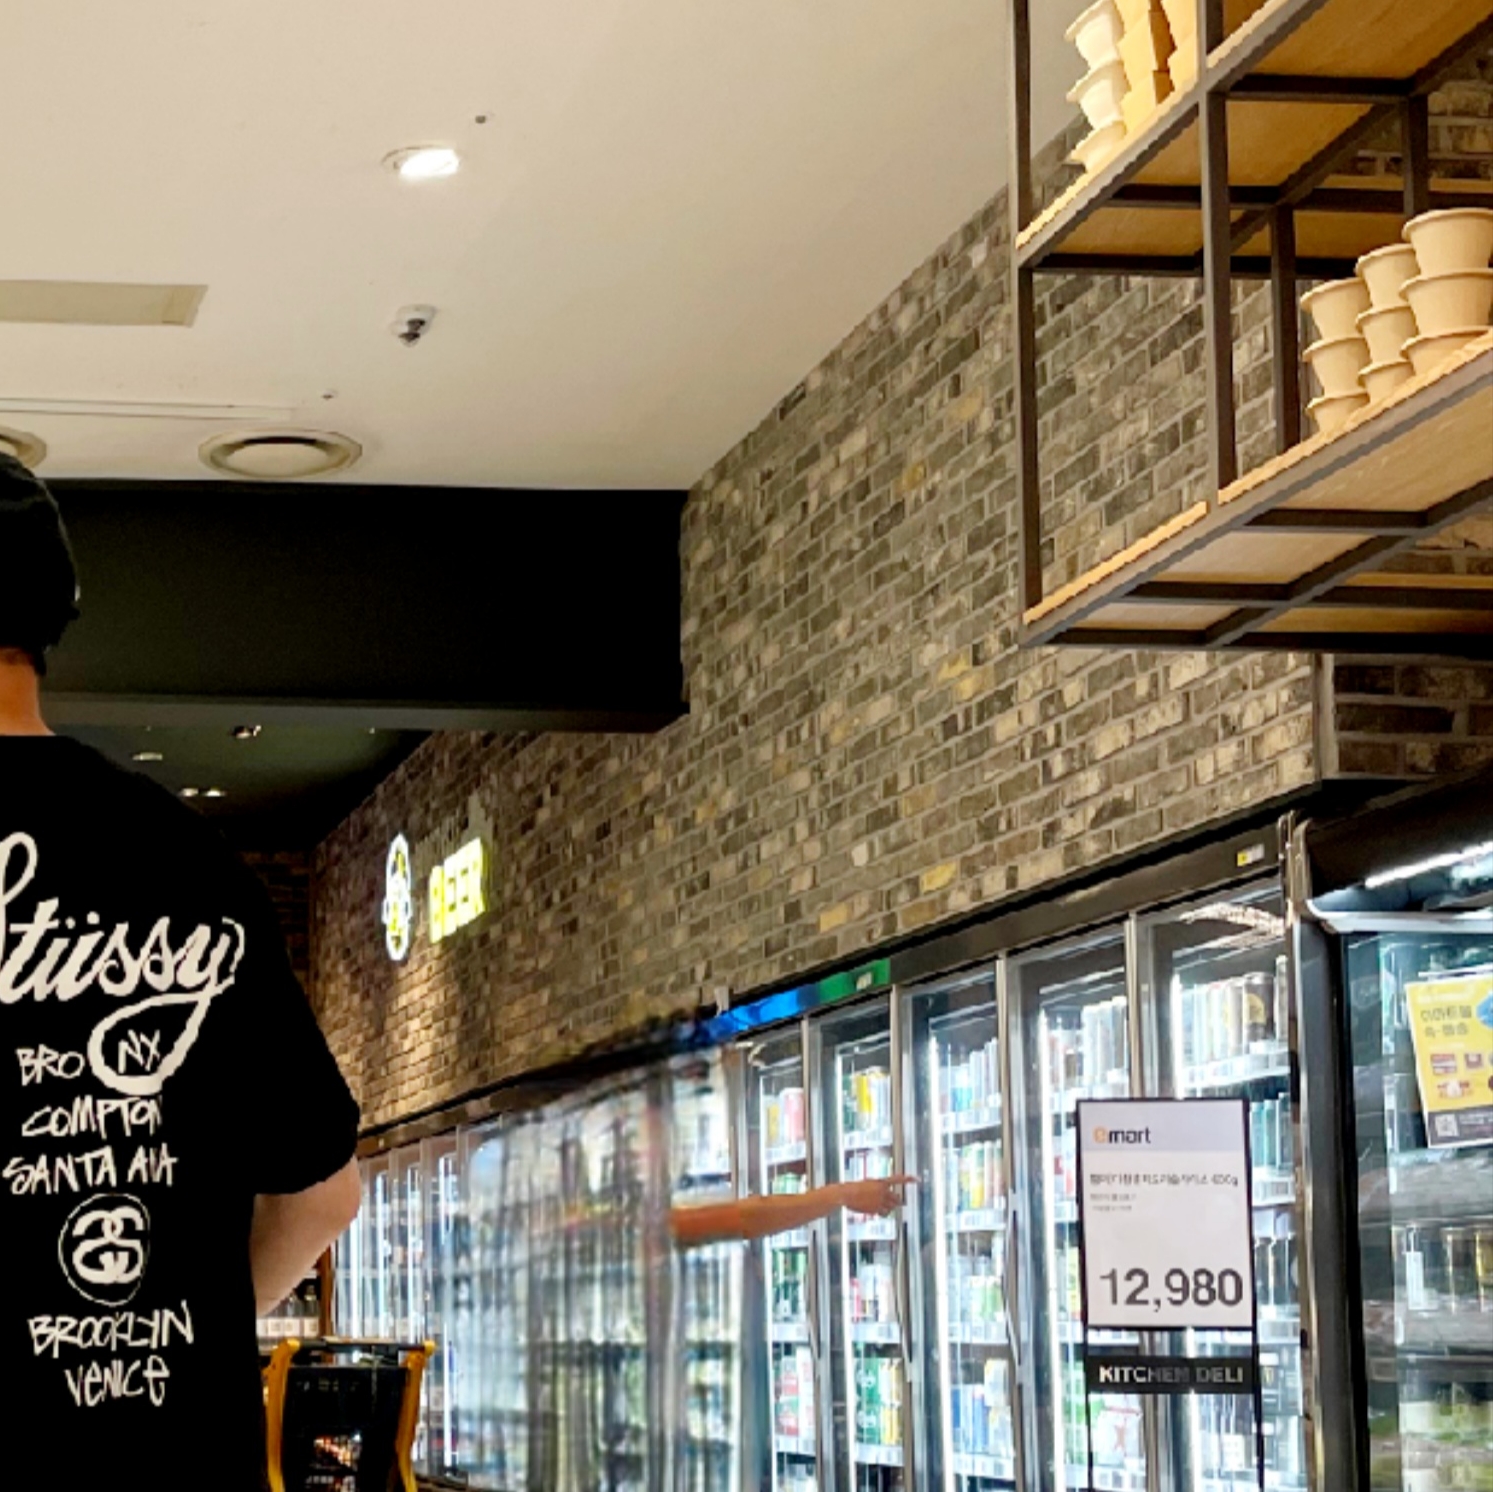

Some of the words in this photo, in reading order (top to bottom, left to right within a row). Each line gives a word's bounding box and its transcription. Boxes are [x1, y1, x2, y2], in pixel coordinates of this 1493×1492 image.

[1093, 1126, 1152, 1145] emart
[1, 1145, 117, 1195] SANTA
[1099, 1267, 1244, 1313] 12,980
[27, 1299, 194, 1359] BROOKLYN
[1098, 1365, 1191, 1384] KITCHEN
[1195, 1366, 1244, 1383] DELI
